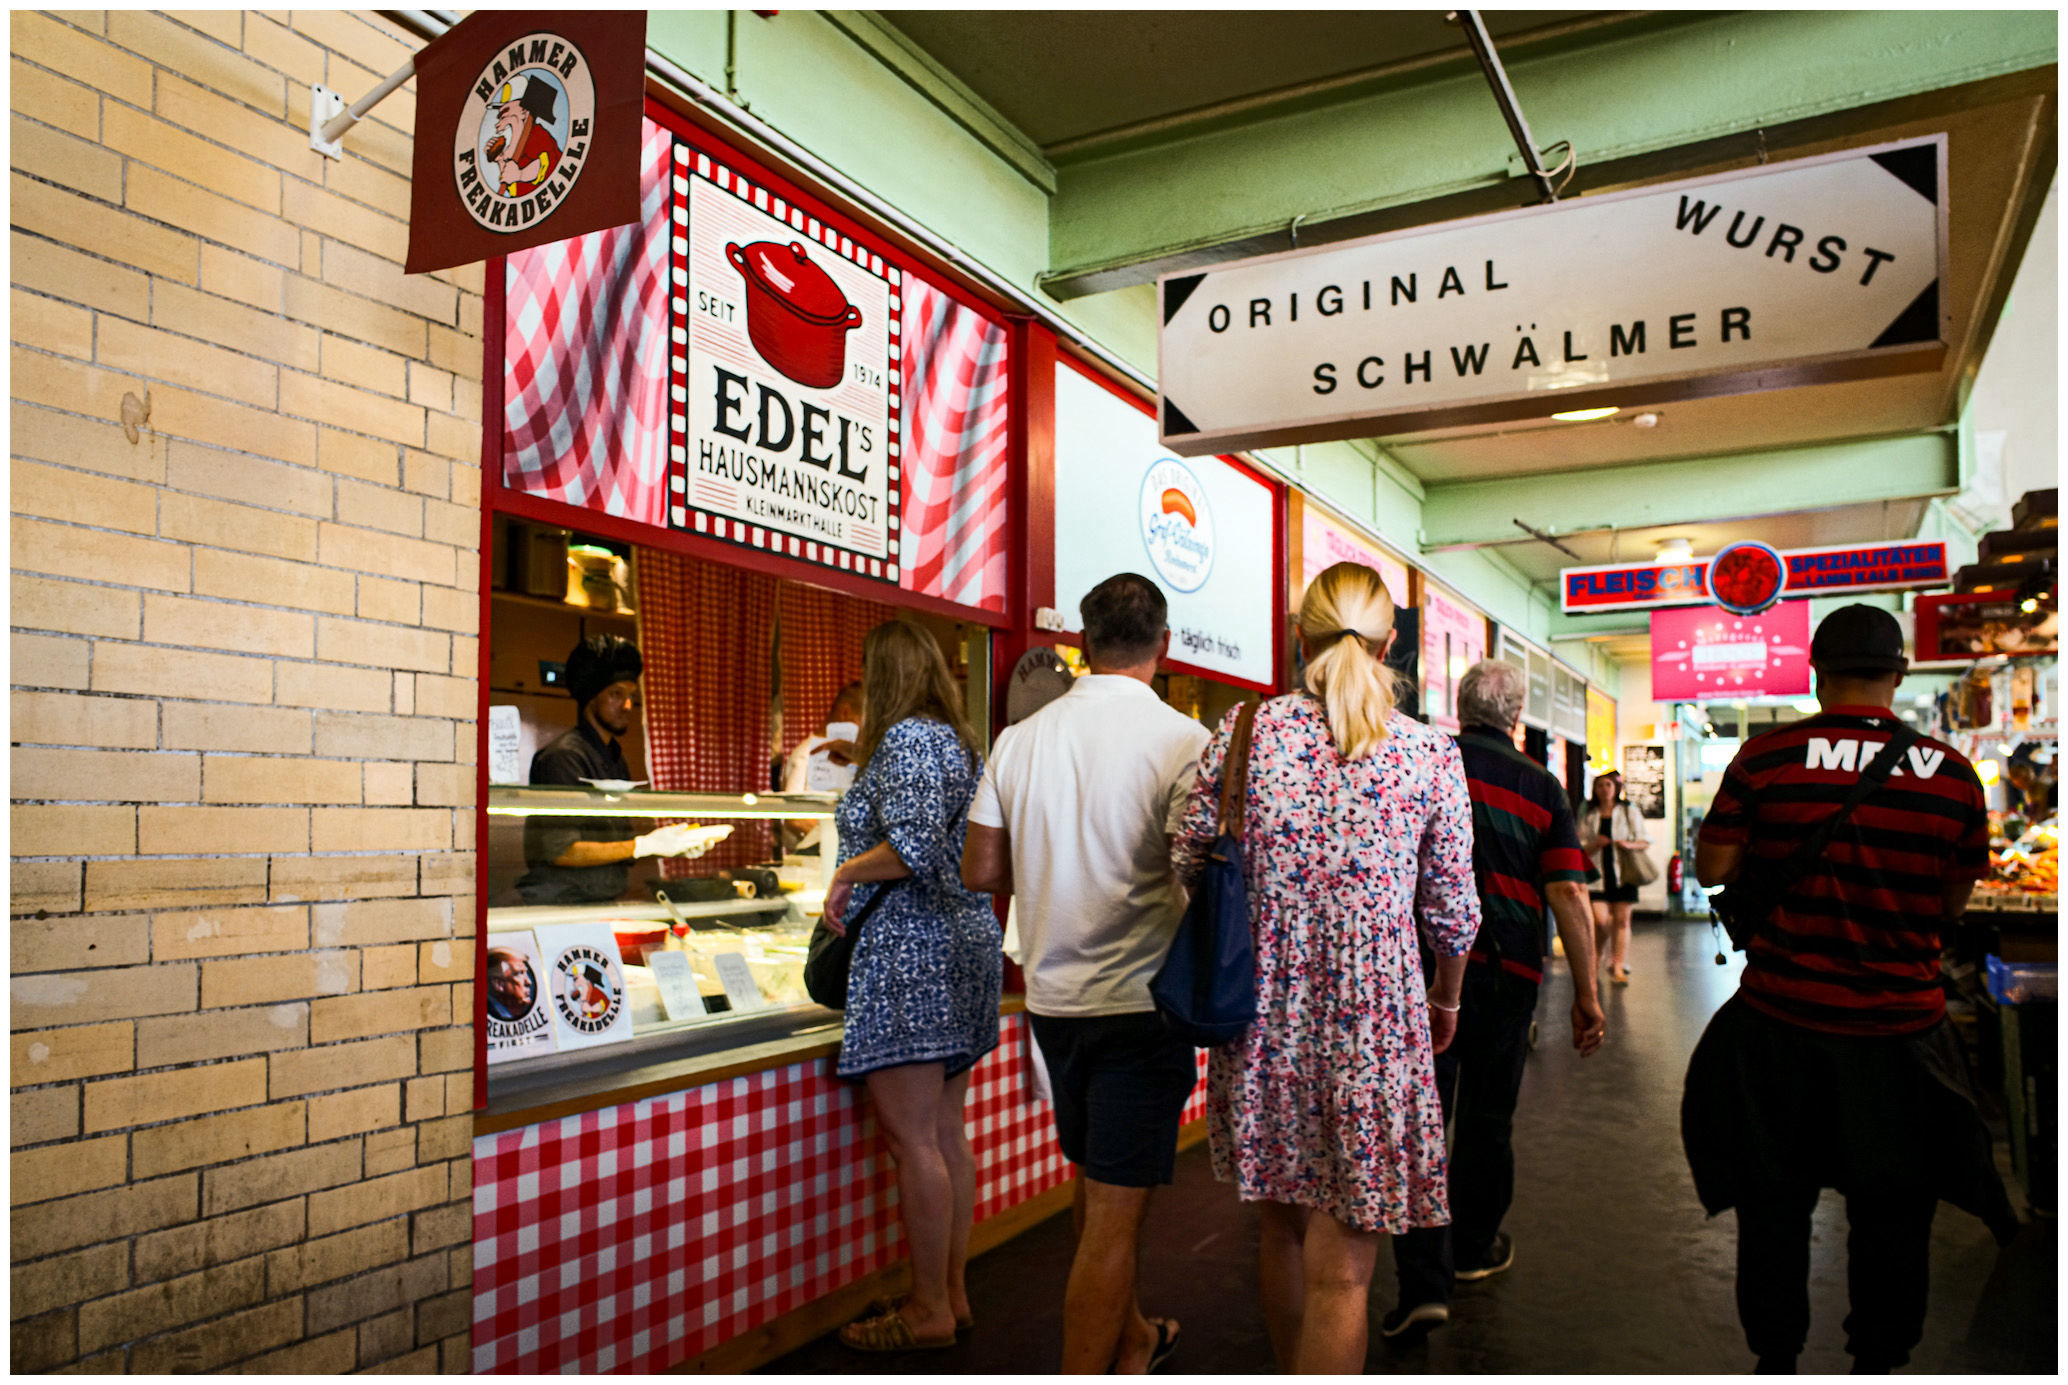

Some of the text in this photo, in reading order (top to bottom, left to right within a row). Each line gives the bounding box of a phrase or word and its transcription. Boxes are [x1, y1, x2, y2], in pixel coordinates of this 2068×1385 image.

[476, 40, 577, 103] HAMMER
[459, 118, 589, 226] FREAKADELLLE
[1675, 195, 1896, 287] WURST
[699, 291, 736, 323] SEIT
[1208, 260, 1508, 333] ORIGINAL
[853, 363, 882, 389] 1974
[1312, 306, 1752, 395] SCHWÄLMER
[712, 365, 872, 484] EDEL'S
[699, 438, 879, 524] HAUSMANNSKOST
[746, 495, 843, 538] KLEINMARKTHALLE
[1569, 565, 1703, 597] FLEISCH
[1790, 545, 1941, 573] SPEZIALITÄTEN
[557, 949, 609, 973] HAMMER
